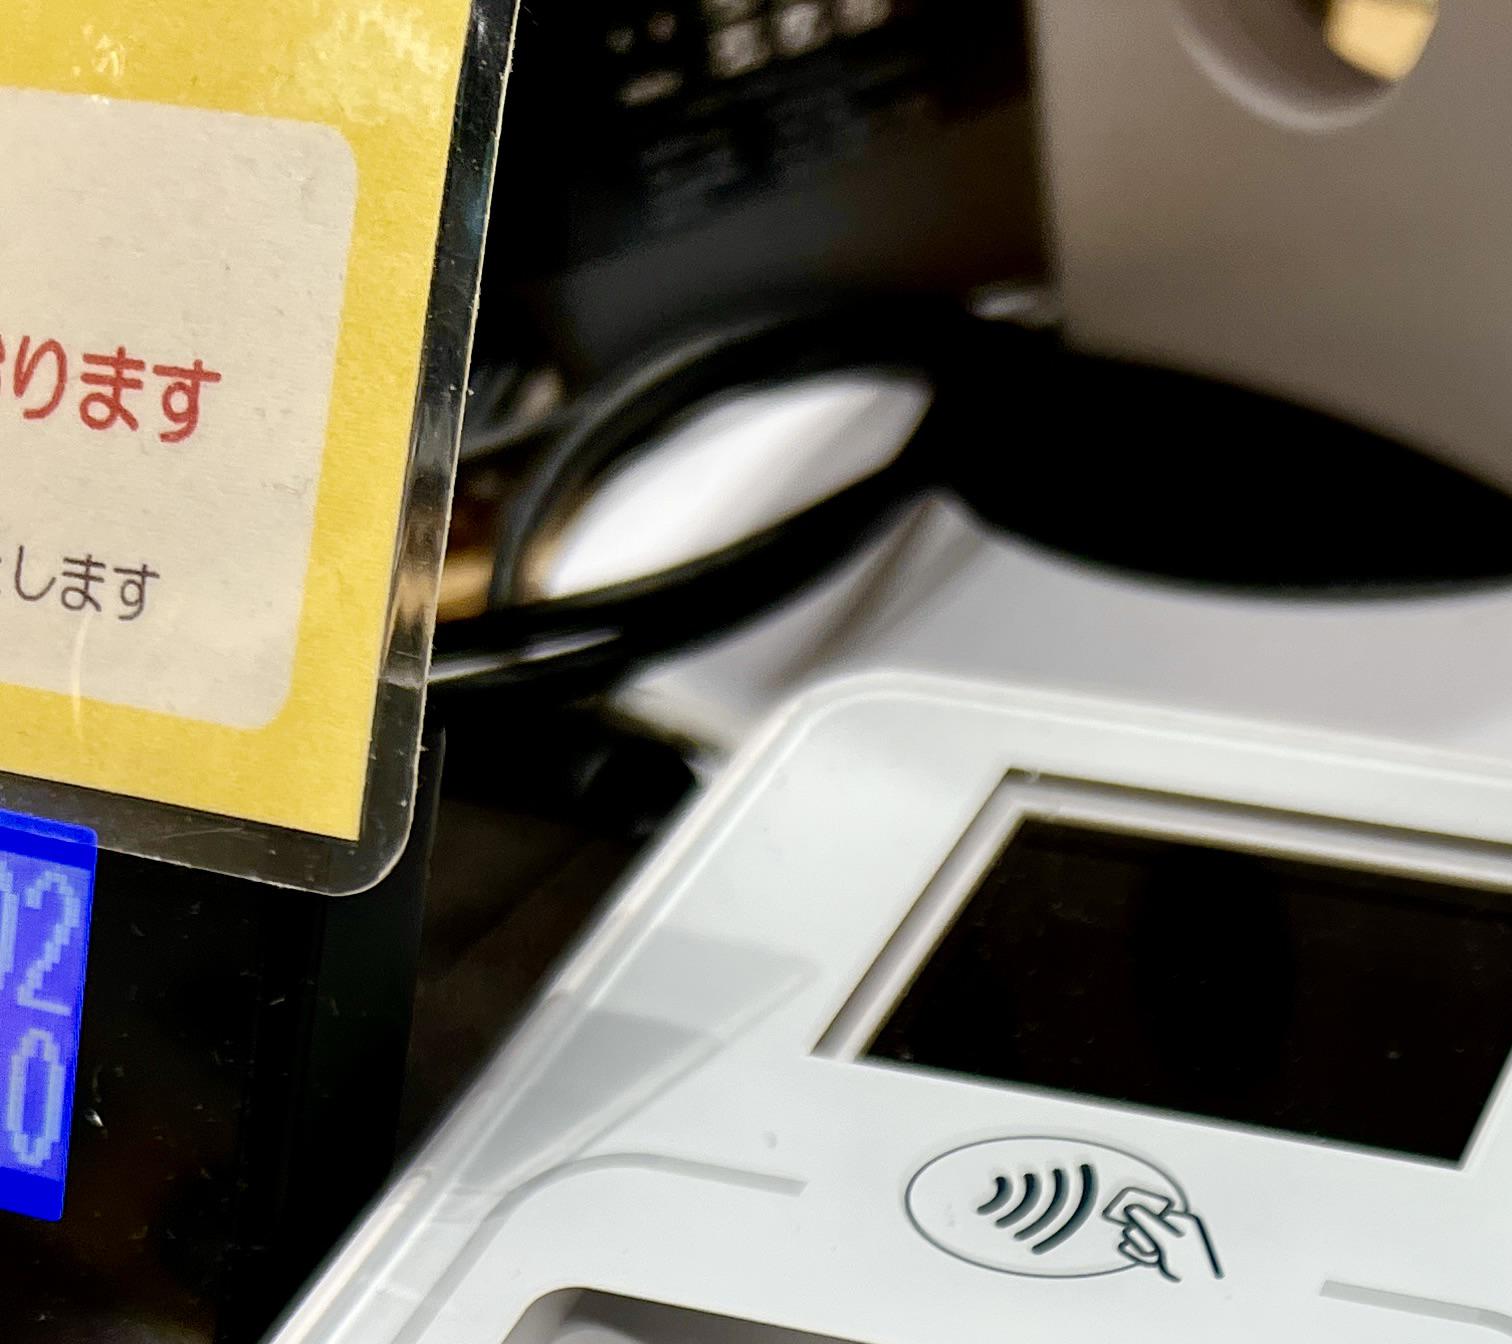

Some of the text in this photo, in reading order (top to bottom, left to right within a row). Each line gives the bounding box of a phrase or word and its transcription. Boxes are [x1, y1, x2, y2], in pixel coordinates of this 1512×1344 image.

[0, 334, 223, 445] ります
[0, 543, 161, 622] します
[6, 1028, 66, 1167] 0
